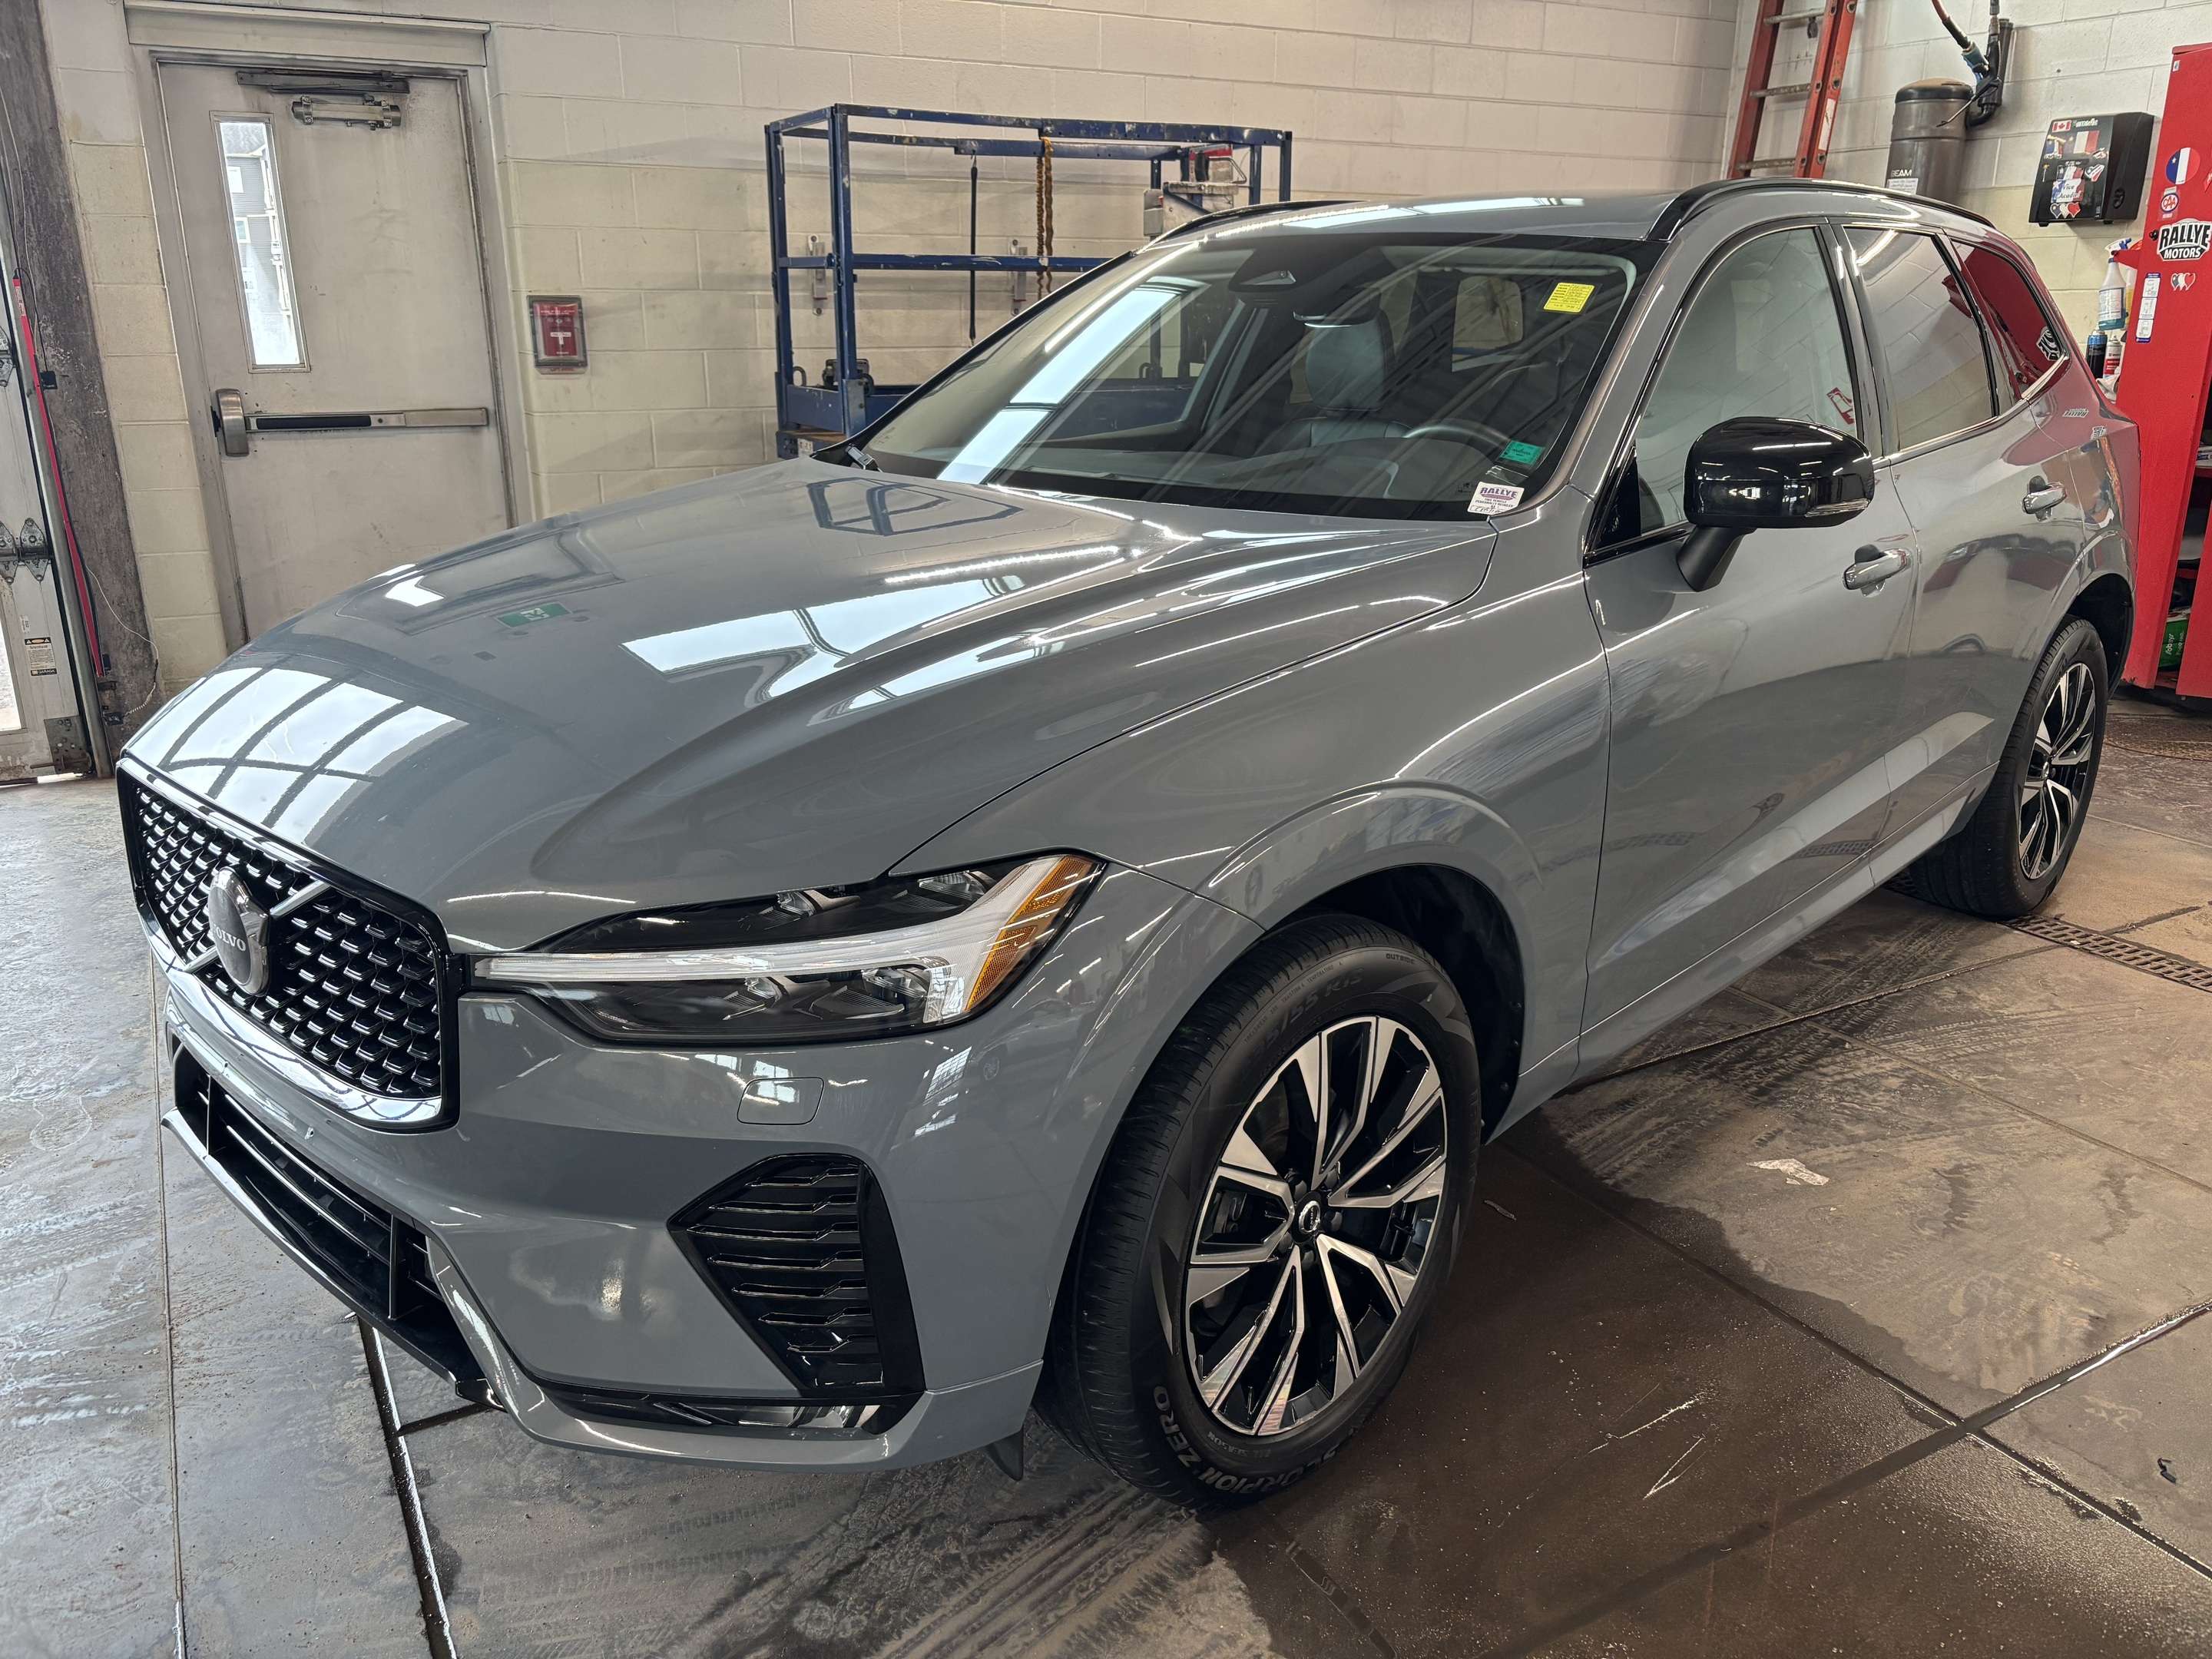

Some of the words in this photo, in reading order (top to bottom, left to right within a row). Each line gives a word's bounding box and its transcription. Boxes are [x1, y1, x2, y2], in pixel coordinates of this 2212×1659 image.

[2159, 224, 2210, 250] RALLYE
[2164, 247, 2201, 260] MOTORS
[1480, 488, 1518, 498] RALLYE
[1386, 953, 1415, 965] OUTSIDE
[1153, 1385, 1203, 1469] ZERO
